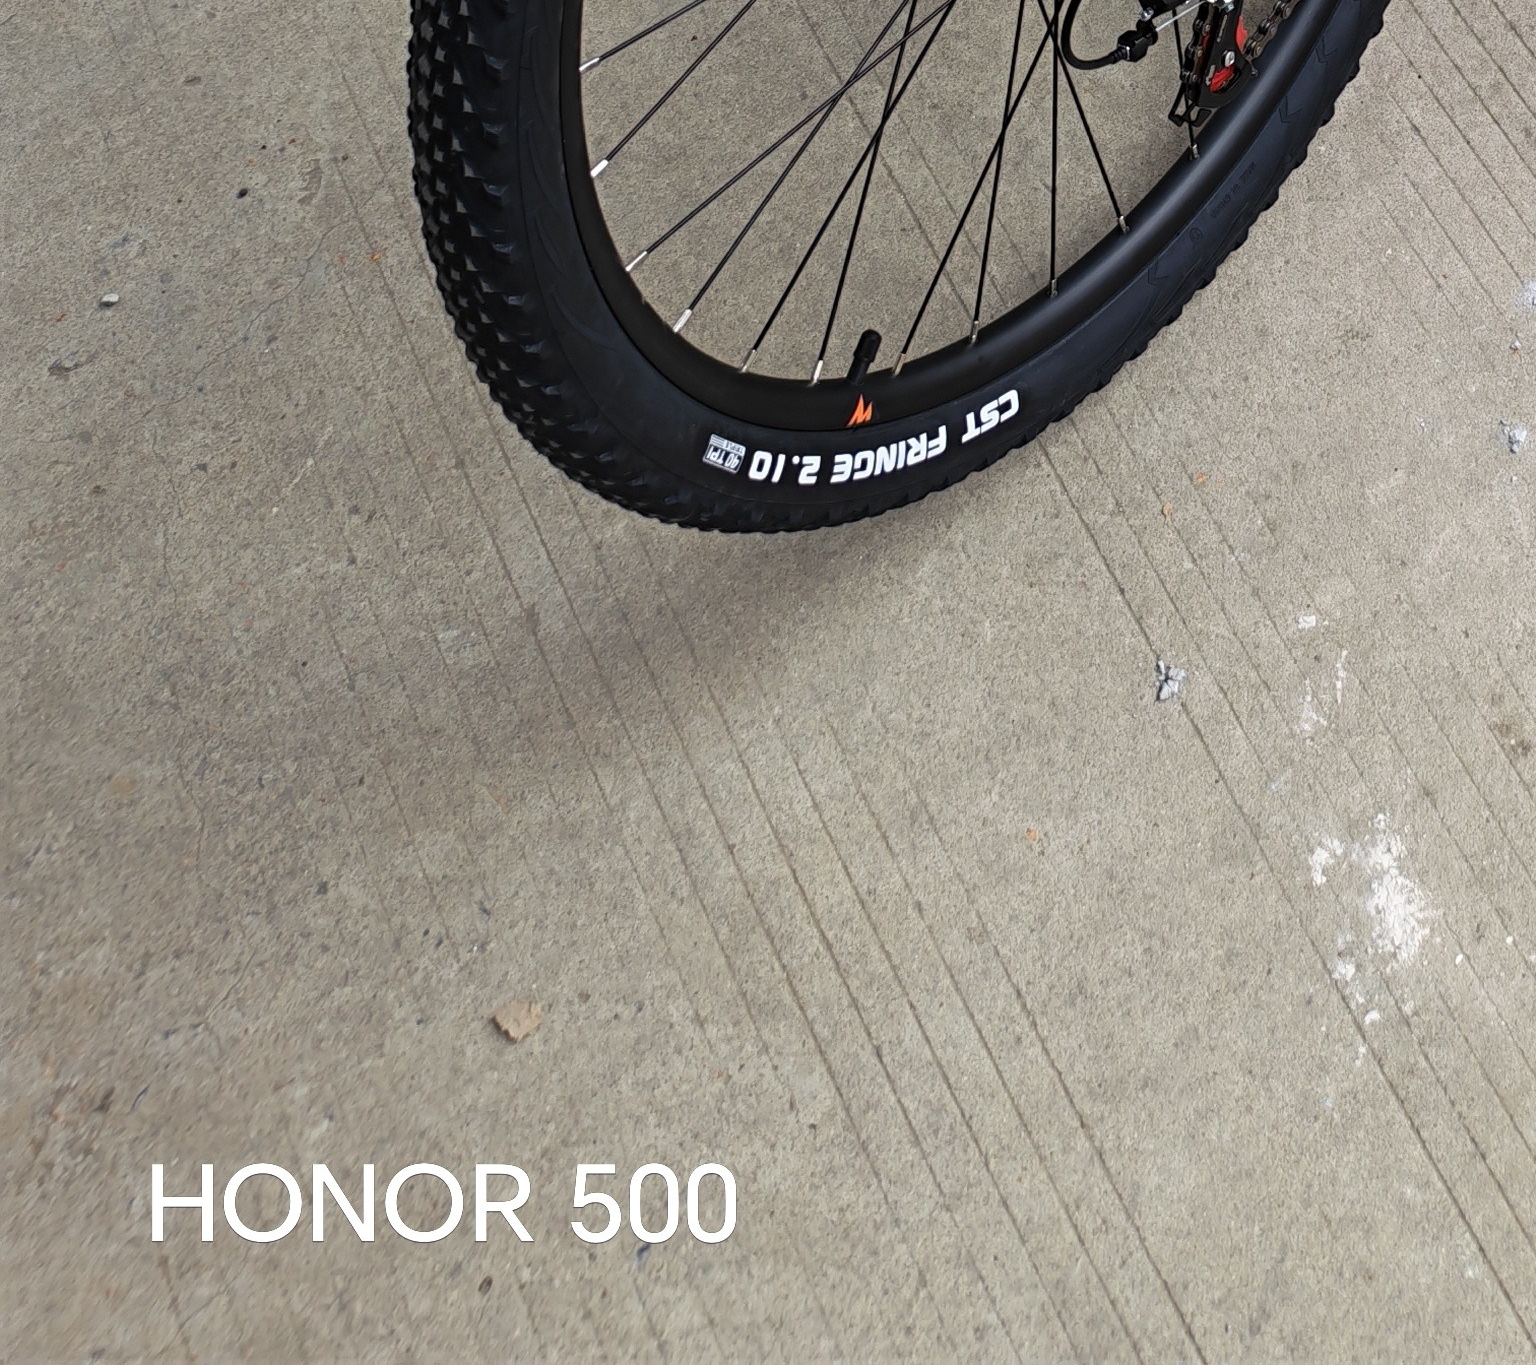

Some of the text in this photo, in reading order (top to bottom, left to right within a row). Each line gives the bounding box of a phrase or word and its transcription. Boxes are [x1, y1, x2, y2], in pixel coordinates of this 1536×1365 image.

[706, 444, 727, 467] TPI
[748, 389, 1020, 485] CST FRINGE 2.10
